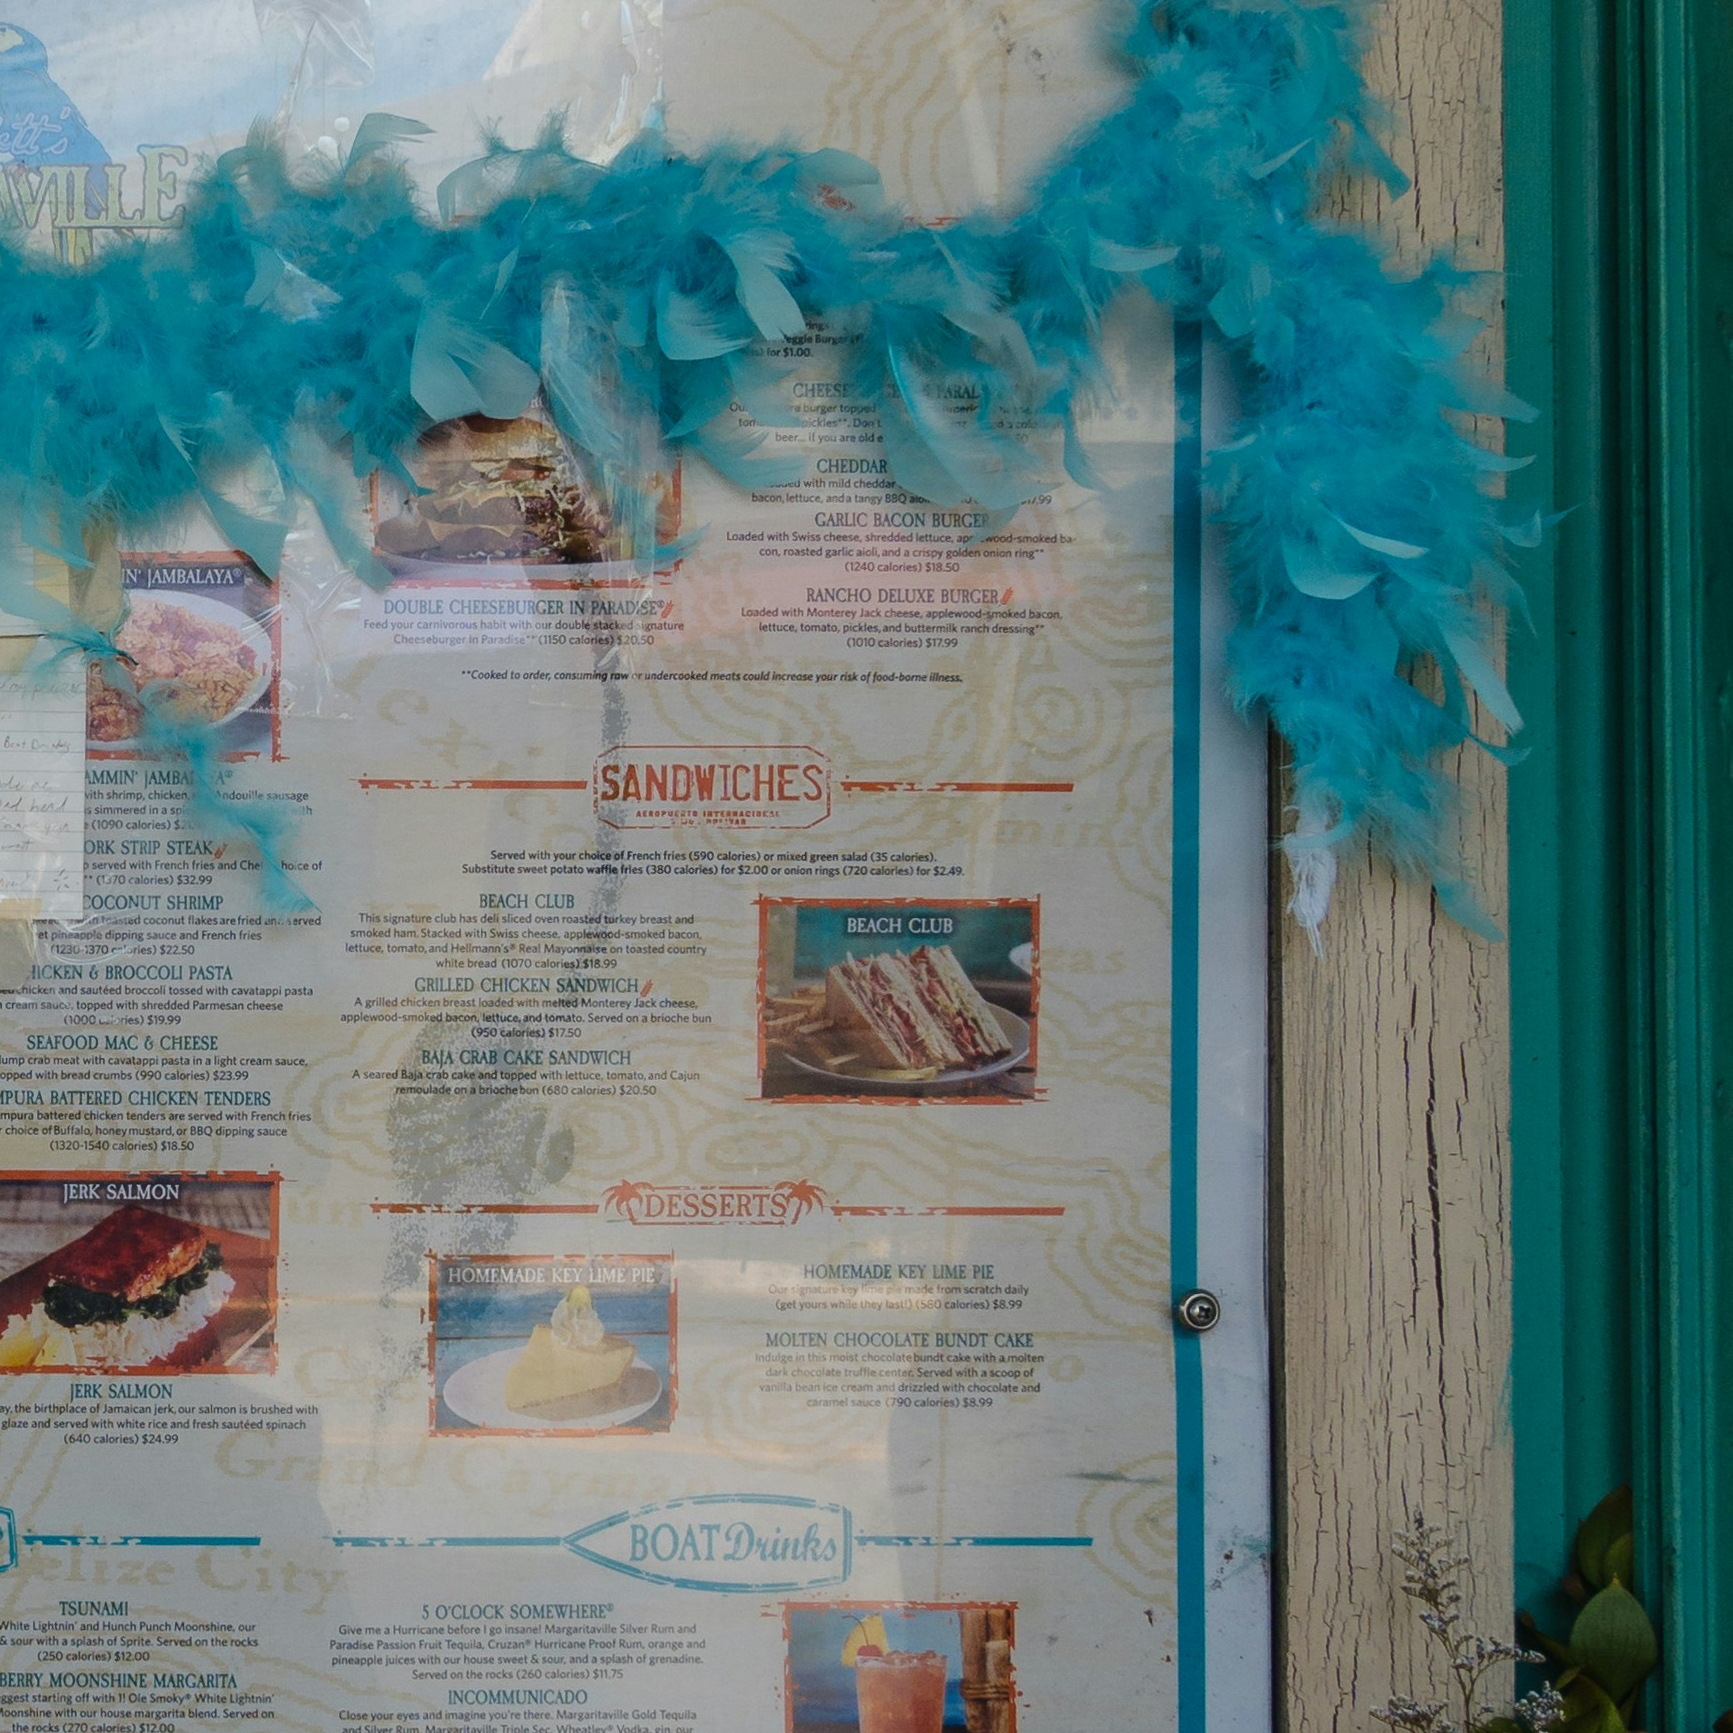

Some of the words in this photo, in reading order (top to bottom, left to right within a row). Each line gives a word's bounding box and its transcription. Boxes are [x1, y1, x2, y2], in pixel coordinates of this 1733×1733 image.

[599, 764, 823, 803] SANDWICHES
[480, 894, 528, 908] BEACH
[535, 894, 574, 909] CLUB
[848, 918, 901, 933] BEACH
[909, 918, 952, 933] CLUB
[415, 977, 474, 992] GRILLED
[480, 978, 550, 993] CHICKEN
[557, 978, 639, 993] SANDWICH
[27, 1035, 98, 1050] SEAFOOD
[105, 1035, 138, 1050] MAC
[144, 1035, 153, 1050] &
[160, 1035, 218, 1050] CHEESE
[51, 1090, 122, 1105] BATTERED
[128, 1091, 198, 1106] CHICKEN
[204, 1091, 271, 1106] TENDERS
[64, 1184, 100, 1203] JERK
[107, 1184, 179, 1200] SALMON
[644, 1190, 788, 1219] DESSERTS
[804, 1264, 892, 1279] HOMEMADE
[898, 1264, 926, 1279] KEY
[933, 1264, 966, 1279] LIME
[972, 1265, 994, 1280] PIE
[64, 1433, 91, 1445] (640
[94, 1434, 139, 1445] calories)
[142, 1434, 178, 1445] $24.99
[629, 1523, 721, 1566] BOAT
[723, 1522, 836, 1561] Drinks
[449, 1689, 588, 1705] INCOMMUNICADO
